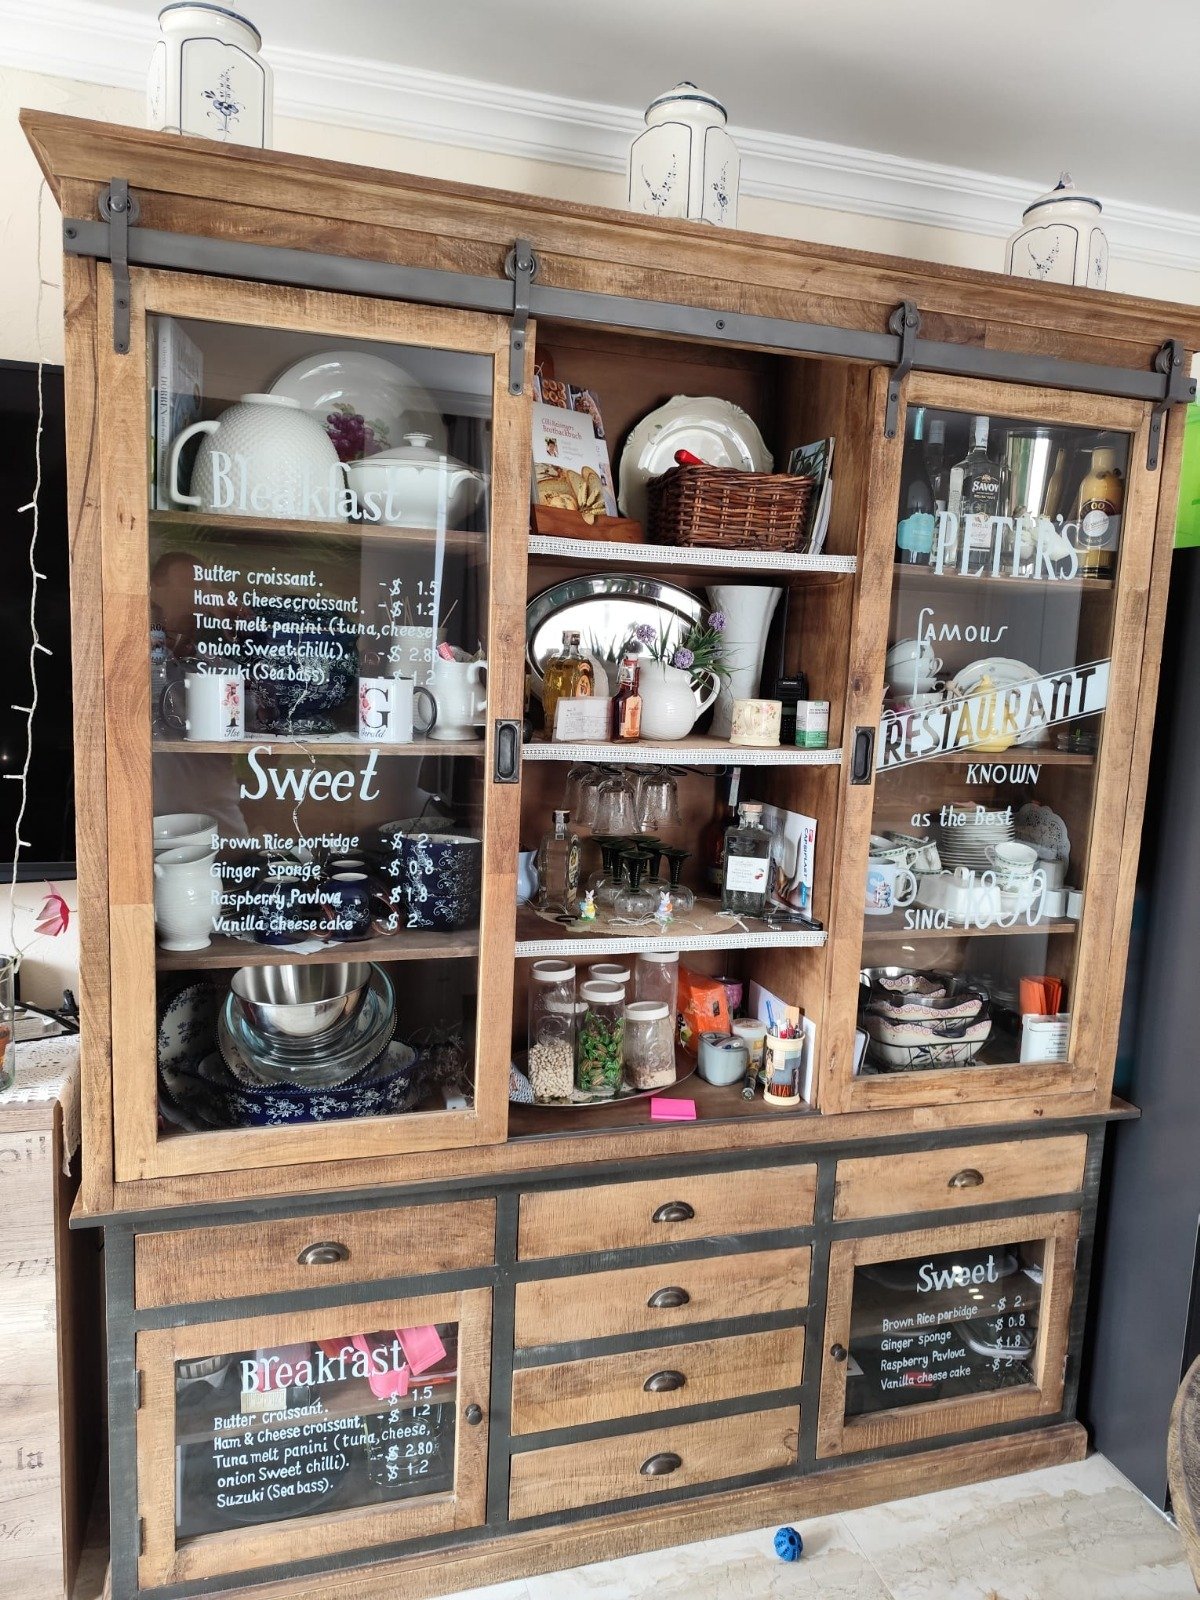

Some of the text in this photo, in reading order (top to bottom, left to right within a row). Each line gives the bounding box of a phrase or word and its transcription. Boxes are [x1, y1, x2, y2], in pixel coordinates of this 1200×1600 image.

[209, 450, 402, 521] Breakfast
[193, 564, 240, 583] Butter
[247, 567, 323, 587] croissant.
[417, 580, 438, 596] 1.5
[193, 590, 226, 606] Ham
[227, 591, 238, 606] &
[416, 602, 438, 616] 1.2
[193, 613, 232, 631] Tuna
[235, 614, 268, 632] melt
[272, 618, 322, 639] panini
[198, 638, 240, 656] onion
[244, 640, 295, 659] Sweet
[362, 687, 391, 729] G
[240, 745, 380, 801] Sweet
[965, 764, 1042, 784] KNOWN
[911, 805, 1014, 827] as the Best
[210, 833, 260, 850] Brown
[264, 832, 294, 850] Rice
[298, 833, 359, 857] porbidge
[209, 861, 260, 883] Ginger
[268, 864, 321, 886] sponge
[210, 888, 286, 911] Raspberry
[290, 889, 342, 905] Pavlova
[211, 915, 264, 932] Vanilla
[903, 908, 953, 930] SINCE
[917, 1254, 999, 1293] Sweet
[882, 1318, 914, 1332] Brown
[916, 1314, 935, 1326] Rice
[881, 1339, 914, 1354] Ginger
[918, 1331, 952, 1345] sponge
[240, 1339, 407, 1394] Breakfast
[881, 1355, 929, 1372] Raspberry
[932, 1347, 966, 1362] Pavlova
[881, 1376, 914, 1390] Vanilla
[917, 1370, 947, 1384] cheese
[950, 1366, 971, 1377] cake
[213, 1415, 257, 1431] Butter
[263, 1402, 329, 1424] croissant.
[412, 1386, 433, 1401] 1.5
[213, 1437, 241, 1451] Ham
[244, 1434, 254, 1446] &
[259, 1426, 301, 1443] Cheese
[303, 1416, 365, 1437] croissant.
[412, 1404, 430, 1417] 1.2
[213, 1453, 248, 1469] Tuna
[251, 1447, 279, 1463] melt
[284, 1439, 328, 1464] panini
[217, 1472, 256, 1488] onion
[260, 1465, 301, 1480] Sweet
[405, 1441, 433, 1457] 2.80
[217, 1491, 264, 1508] Suzuki
[408, 1460, 429, 1475] 1.2
